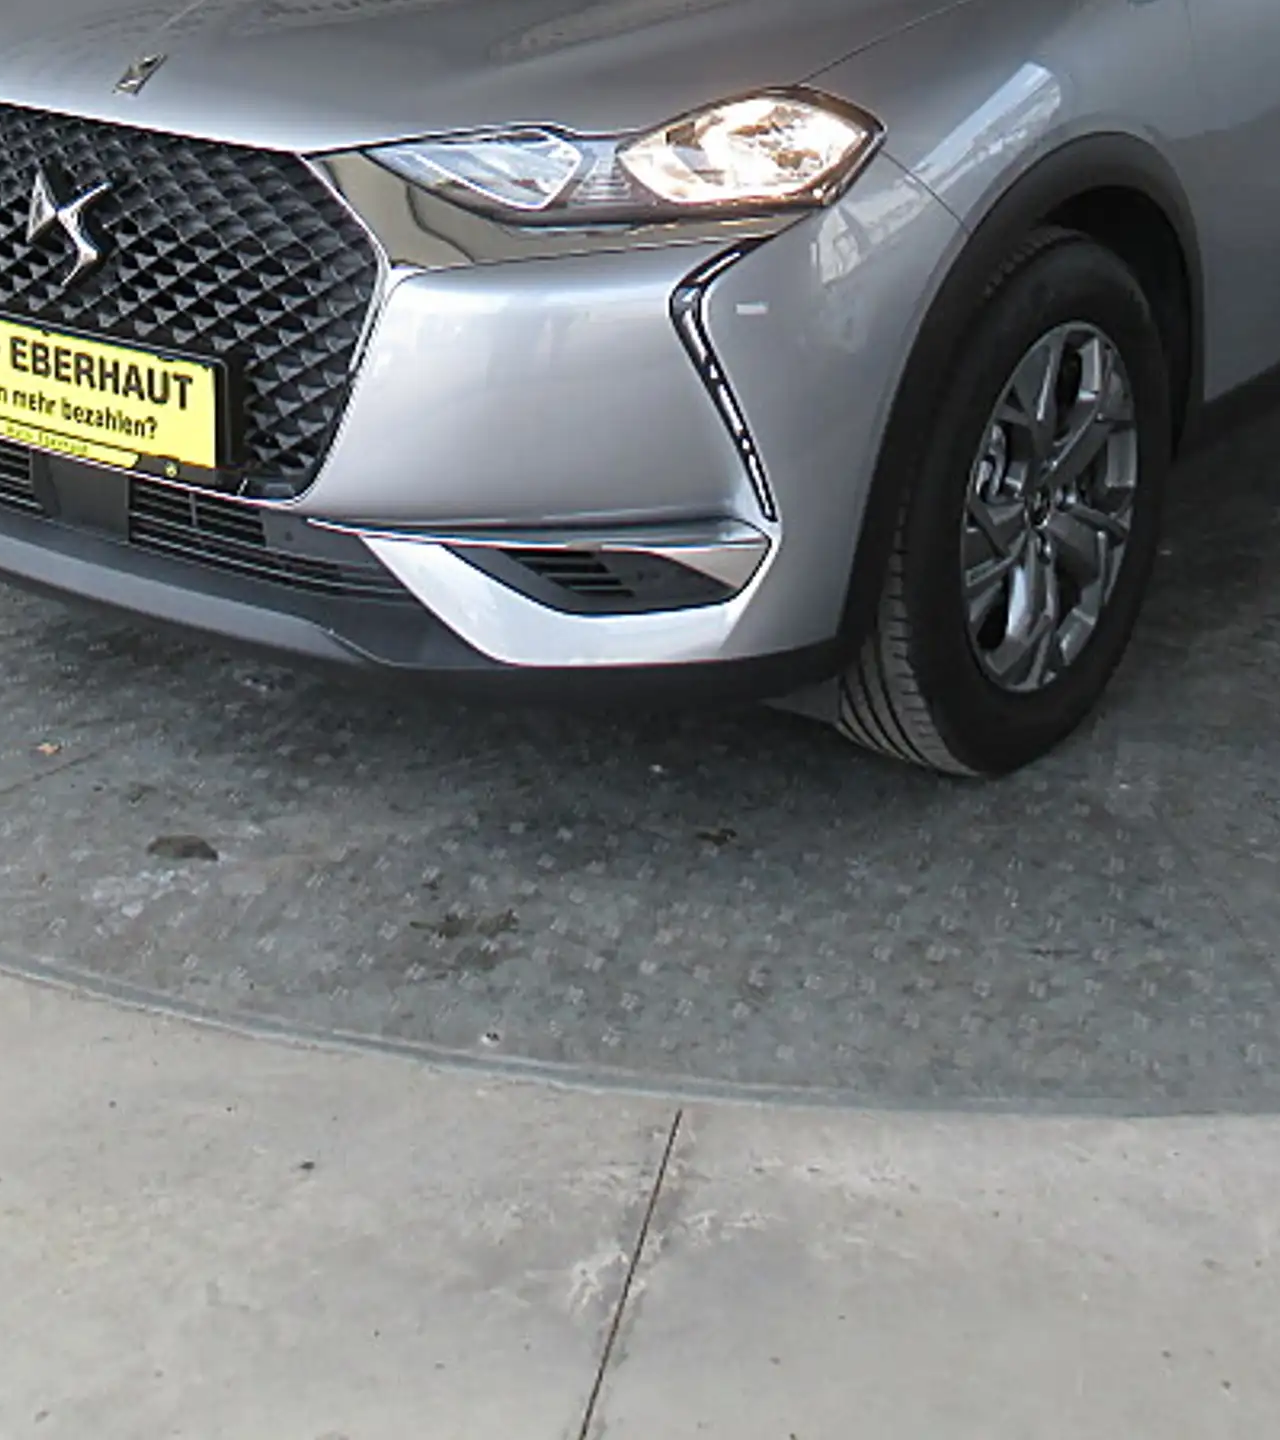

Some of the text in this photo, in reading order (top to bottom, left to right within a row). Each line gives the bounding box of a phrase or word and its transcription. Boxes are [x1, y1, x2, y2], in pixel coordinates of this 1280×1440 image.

[9, 336, 194, 410] EBERHAUT
[12, 389, 57, 416] mehr
[61, 397, 159, 440] bezahlen?
